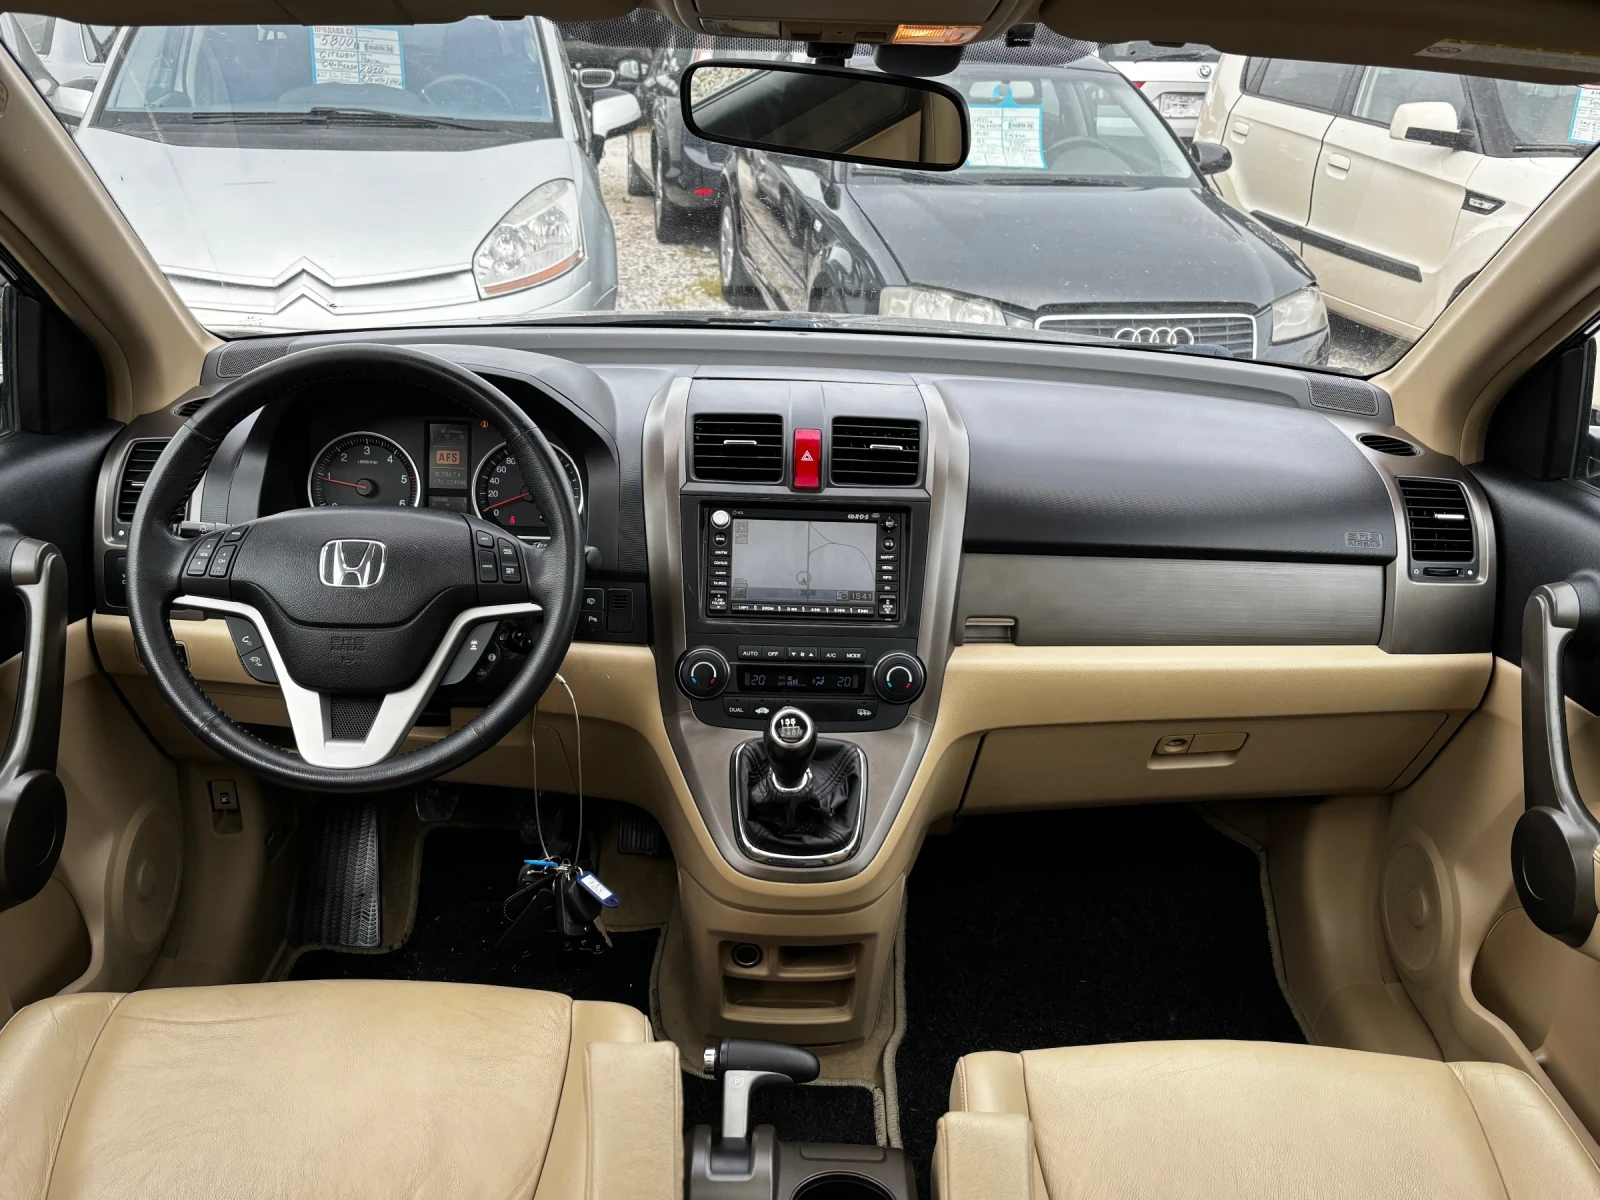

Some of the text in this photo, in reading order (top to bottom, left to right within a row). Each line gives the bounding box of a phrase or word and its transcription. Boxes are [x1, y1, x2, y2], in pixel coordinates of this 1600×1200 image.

[314, 26, 345, 35] ПРОДАВА
[346, 28, 355, 36] СЕ
[320, 35, 354, 47] 5800
[363, 446, 371, 456] 3
[340, 453, 348, 462] 2
[386, 455, 394, 463] 4
[438, 453, 458, 462] AFS
[505, 457, 516, 465] 80
[496, 465, 507, 473] 60
[400, 474, 408, 484] 5
[489, 477, 500, 485] 40
[487, 489, 499, 498] 20
[493, 508, 500, 517] 0
[750, 674, 766, 686] 20
[836, 676, 852, 687] 20
